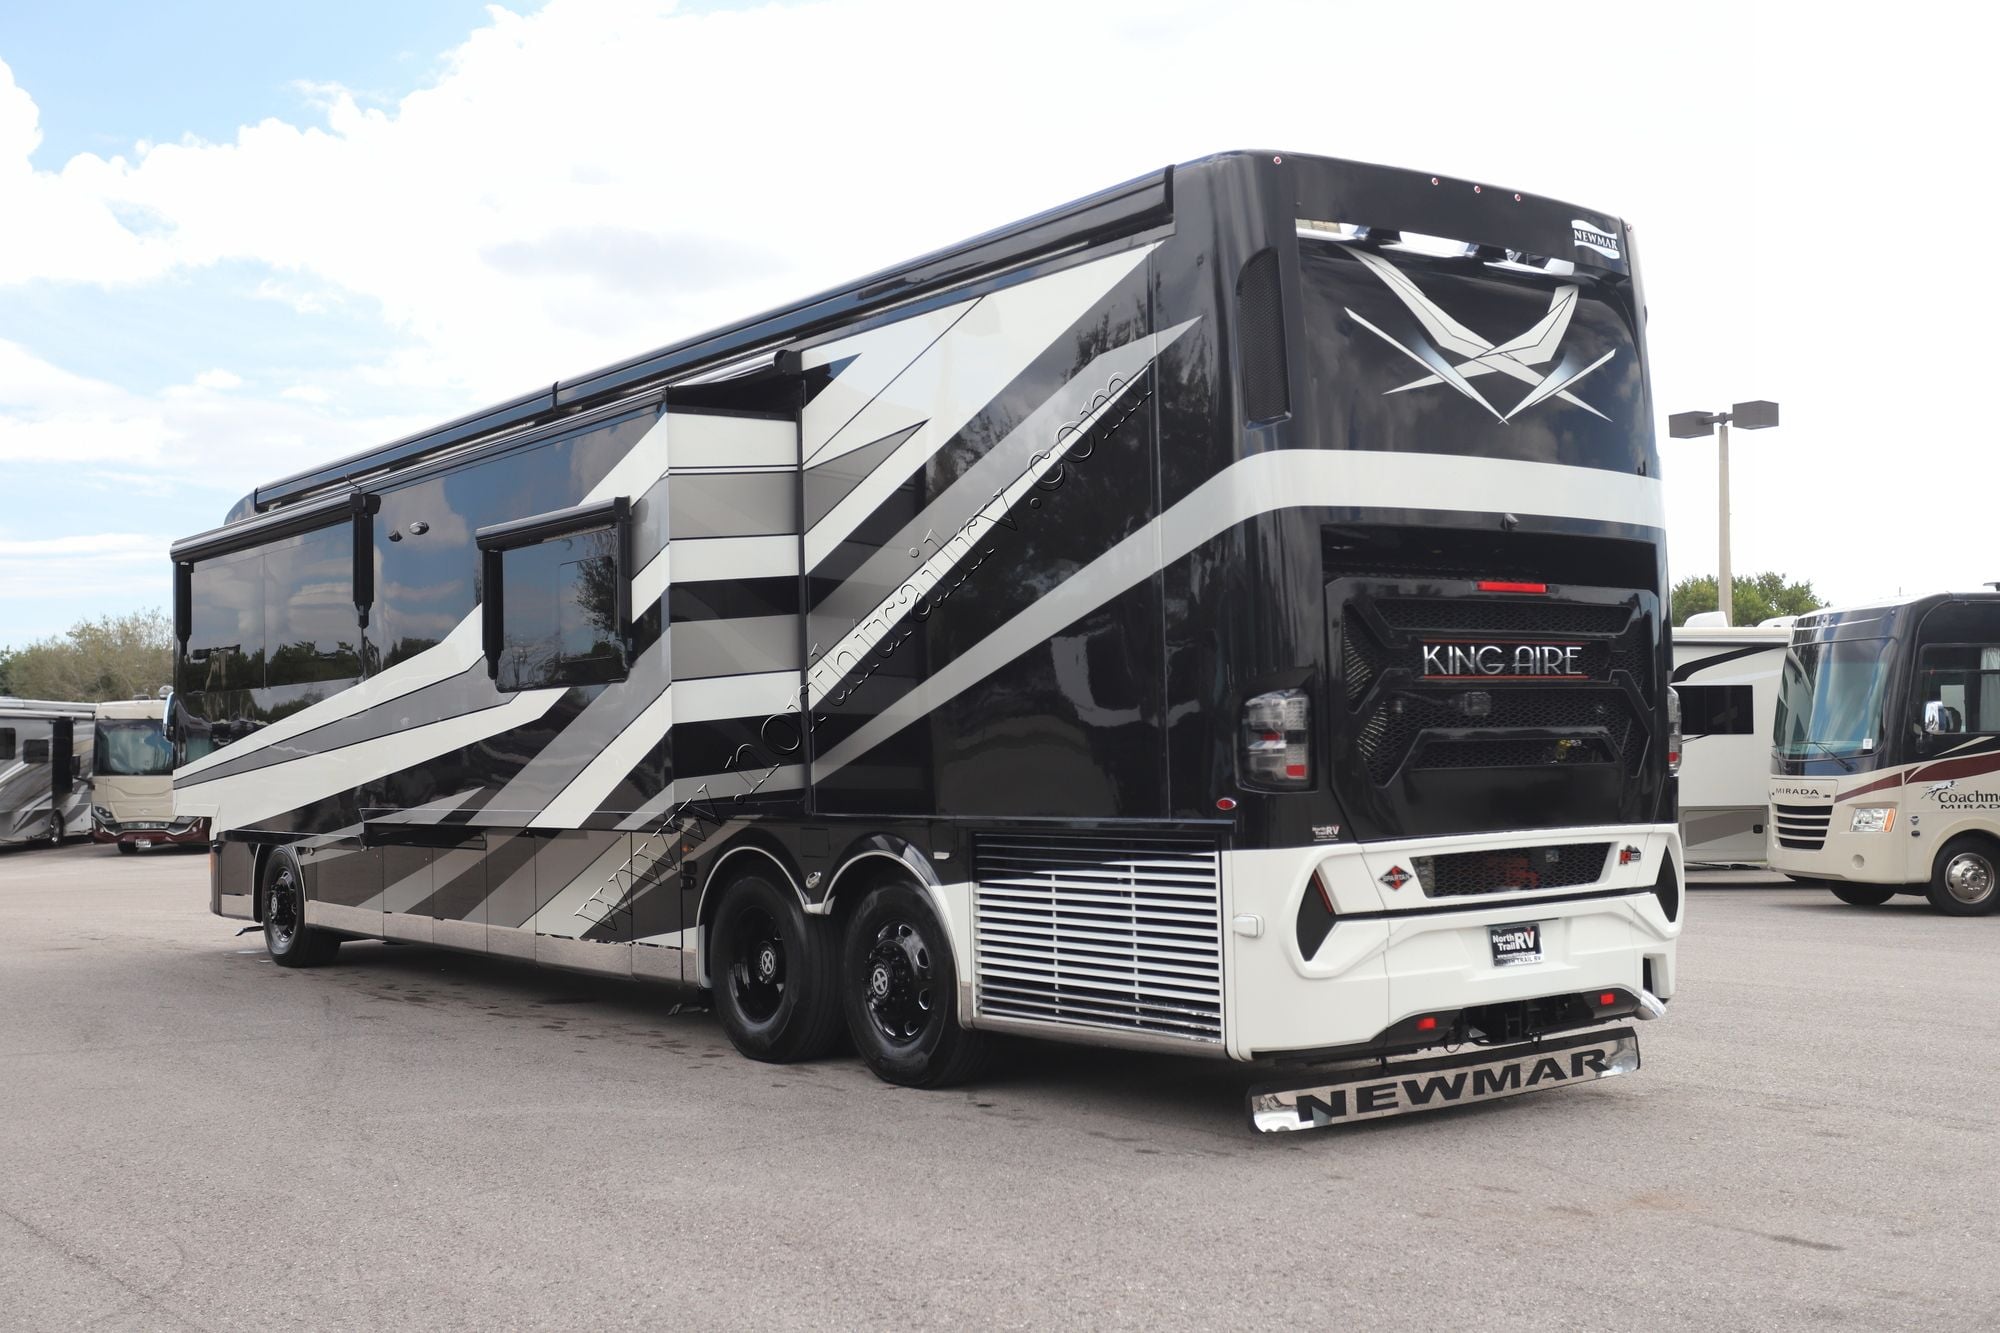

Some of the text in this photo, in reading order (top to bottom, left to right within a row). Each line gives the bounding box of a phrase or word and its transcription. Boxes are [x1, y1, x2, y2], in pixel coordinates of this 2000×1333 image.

[1574, 229, 1618, 250] NEWMAR
[1423, 645, 1582, 675] KING AIRE
[1776, 787, 1819, 796] MIRADA
[1326, 825, 1340, 835] RV
[1492, 933, 1515, 943] North
[1514, 930, 1535, 950] RV
[1497, 941, 1516, 951] Trail
[1296, 1048, 1610, 1122] NEWMAR
